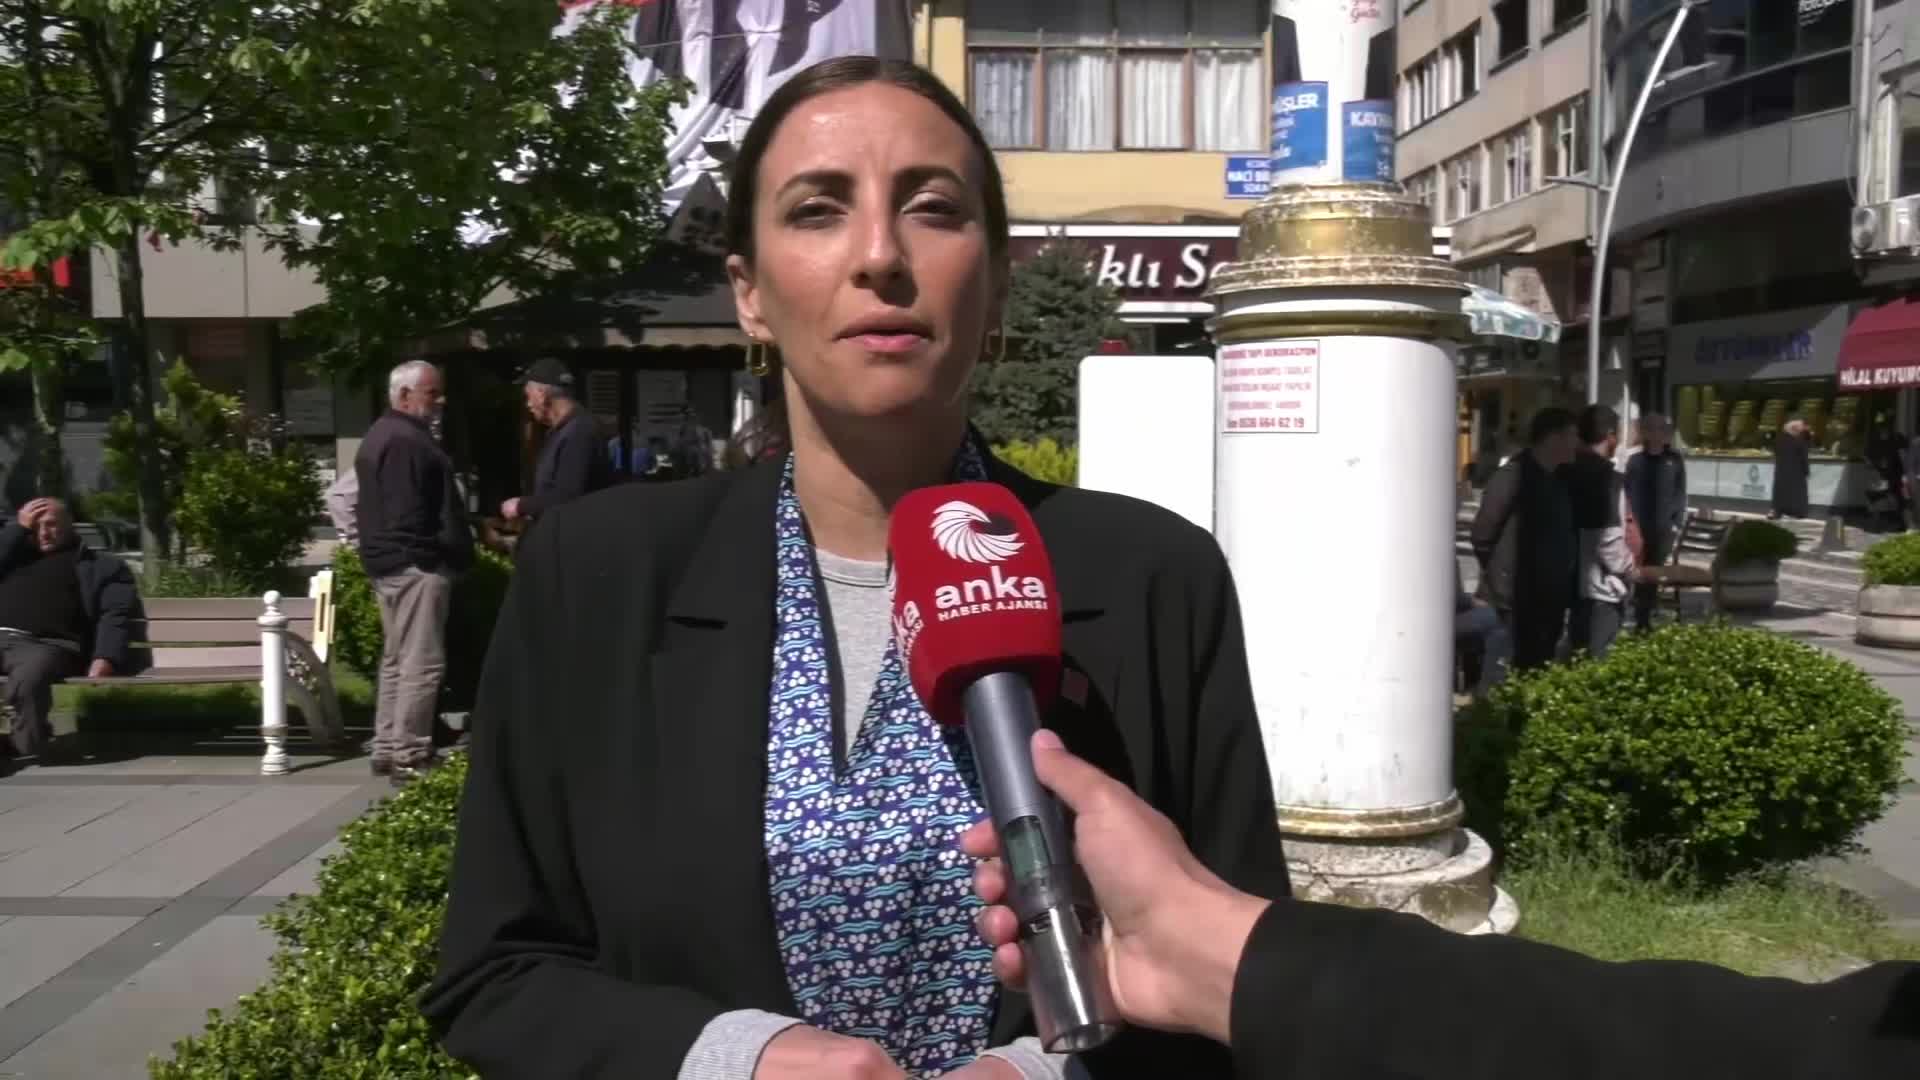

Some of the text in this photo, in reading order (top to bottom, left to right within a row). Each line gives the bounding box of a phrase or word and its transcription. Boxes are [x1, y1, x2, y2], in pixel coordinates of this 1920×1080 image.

[1085, 244, 1162, 288] klı
[1840, 367, 1871, 386] HİLAL
[935, 565, 1048, 609] anka
[937, 599, 1048, 622] HABER AJANSI
